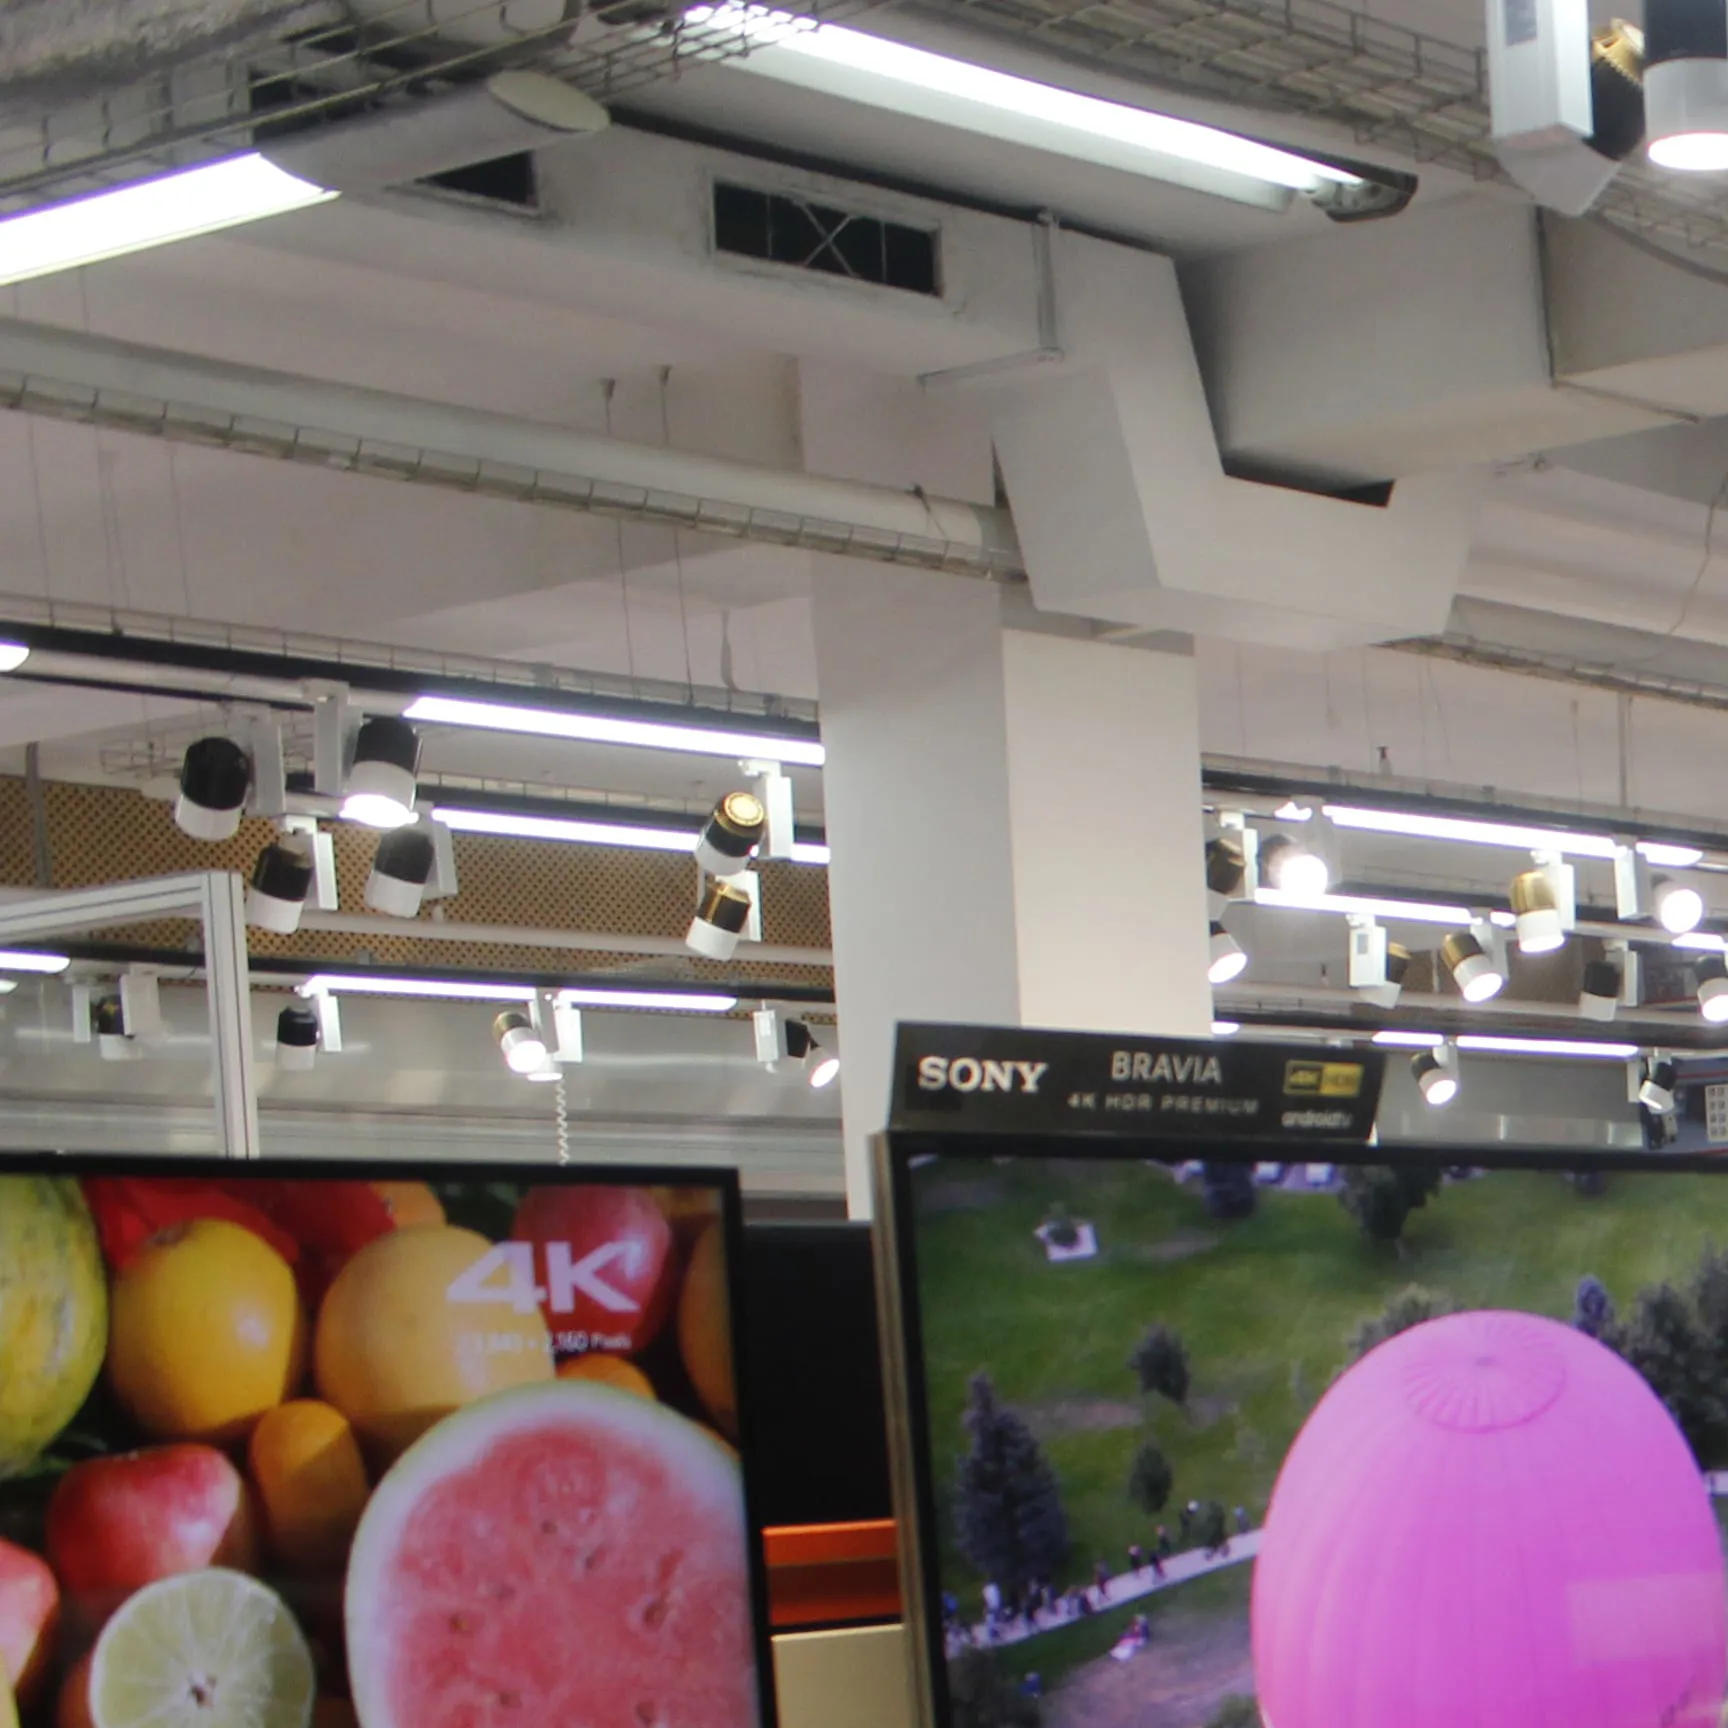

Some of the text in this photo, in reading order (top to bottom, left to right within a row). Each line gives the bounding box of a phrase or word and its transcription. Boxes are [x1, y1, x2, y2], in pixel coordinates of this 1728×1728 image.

[917, 1056, 1047, 1093] SONY
[1111, 1051, 1222, 1083] BRAVIA
[1067, 1093, 1095, 1110] 4K
[1160, 1094, 1259, 1114] PREMIUM
[447, 1240, 648, 1315] 4K
